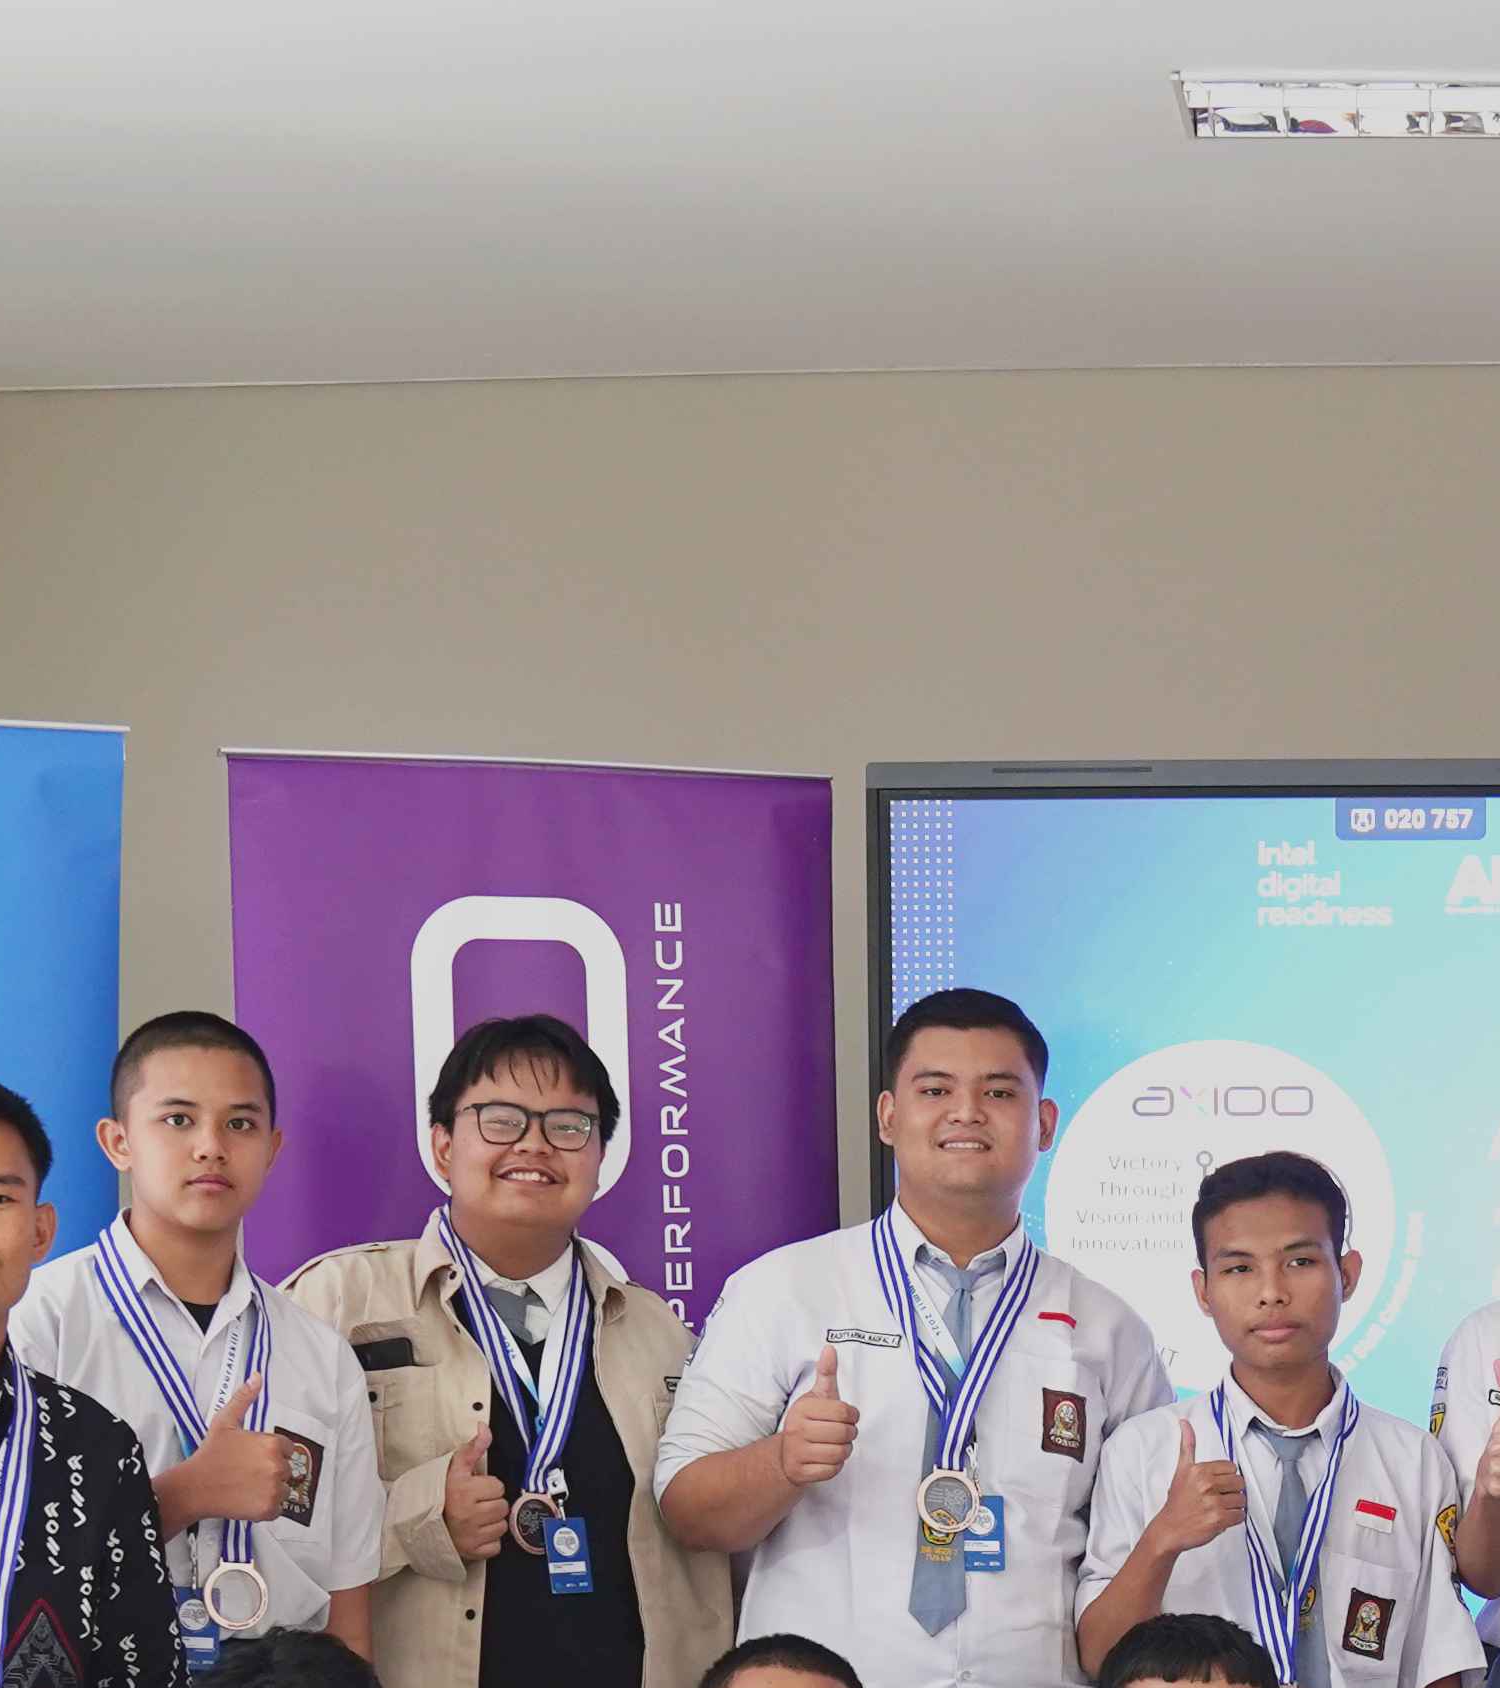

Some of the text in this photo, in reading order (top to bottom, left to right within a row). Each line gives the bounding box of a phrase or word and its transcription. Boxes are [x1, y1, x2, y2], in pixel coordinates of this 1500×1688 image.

[1383, 808, 1474, 831] 020 757
[1258, 841, 1315, 866] intel
[1258, 872, 1342, 901] digital
[1258, 901, 1392, 927] readiness
[654, 900, 694, 1328] PERFORMANCE
[1107, 1155, 1182, 1173] Victory
[1099, 1181, 1185, 1199] Through
[1075, 1209, 1185, 1225] Vision and
[1071, 1236, 1185, 1252] Innovation
